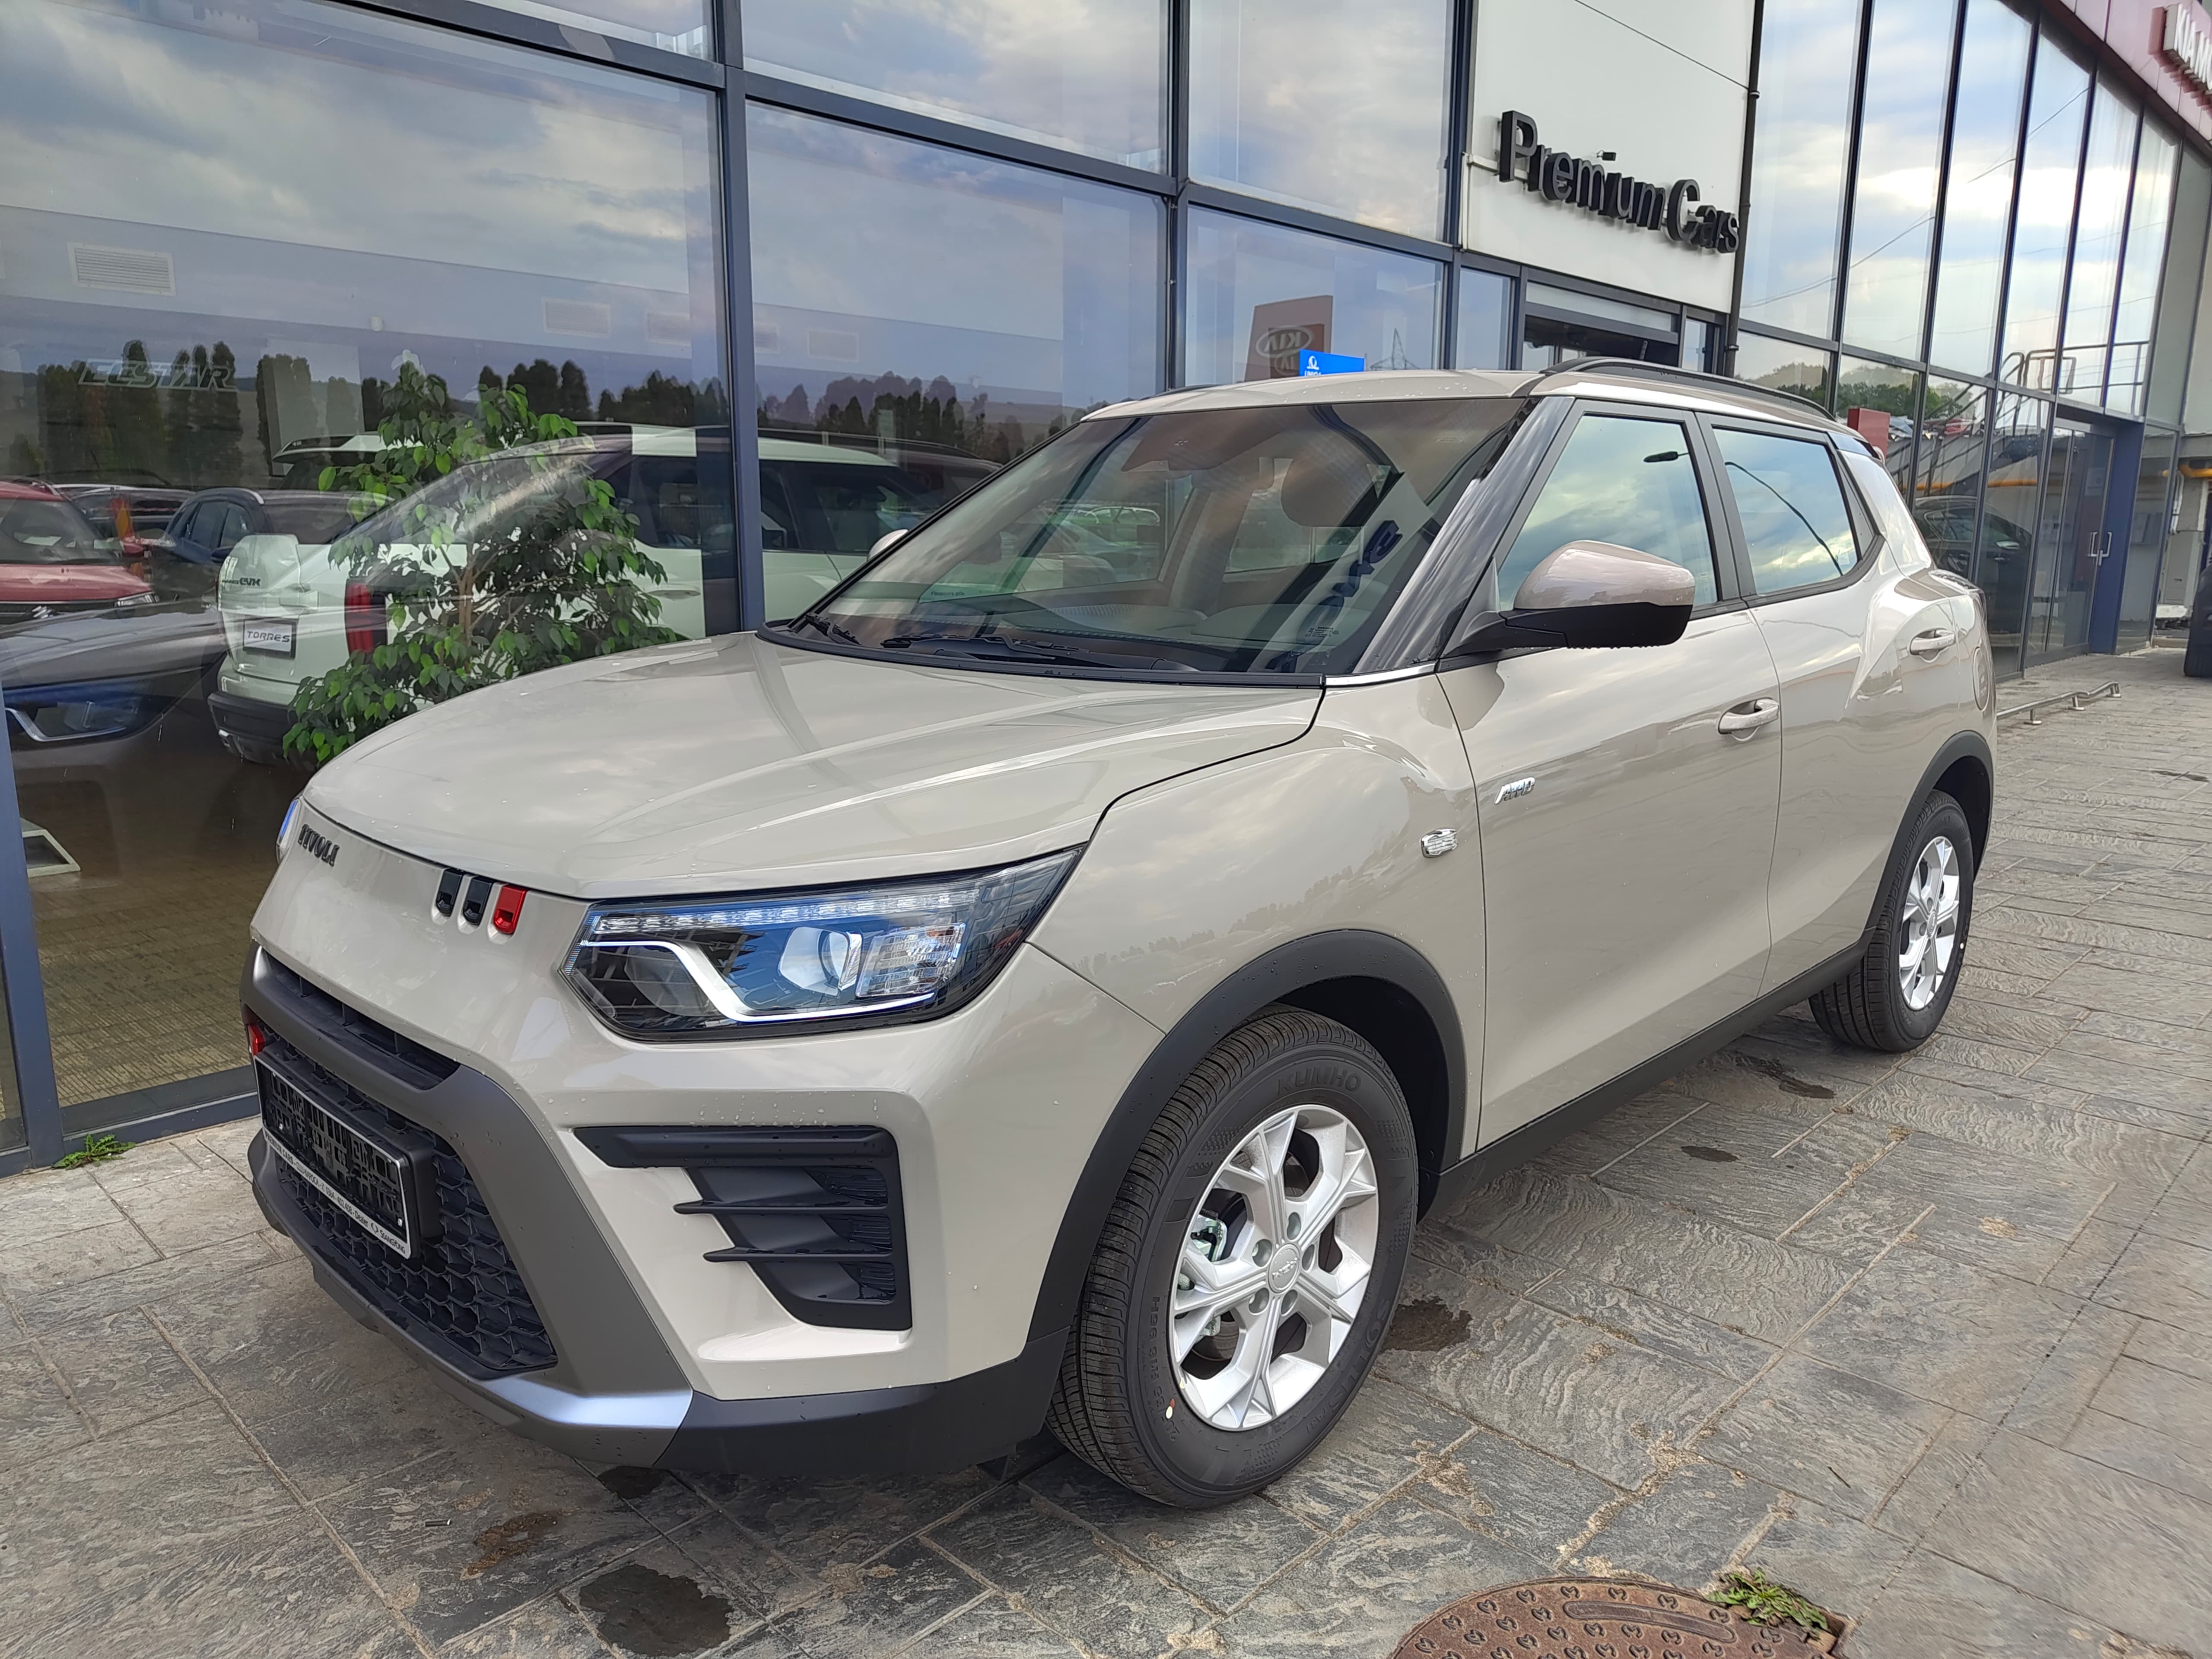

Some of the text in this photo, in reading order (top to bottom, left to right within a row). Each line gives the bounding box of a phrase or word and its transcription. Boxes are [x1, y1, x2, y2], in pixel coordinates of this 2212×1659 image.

[1500, 110, 1740, 253] Premium Cars
[247, 631, 291, 643] TORRES
[298, 824, 340, 868] TIVOLI
[1277, 1066, 1361, 1095] KUMHO
